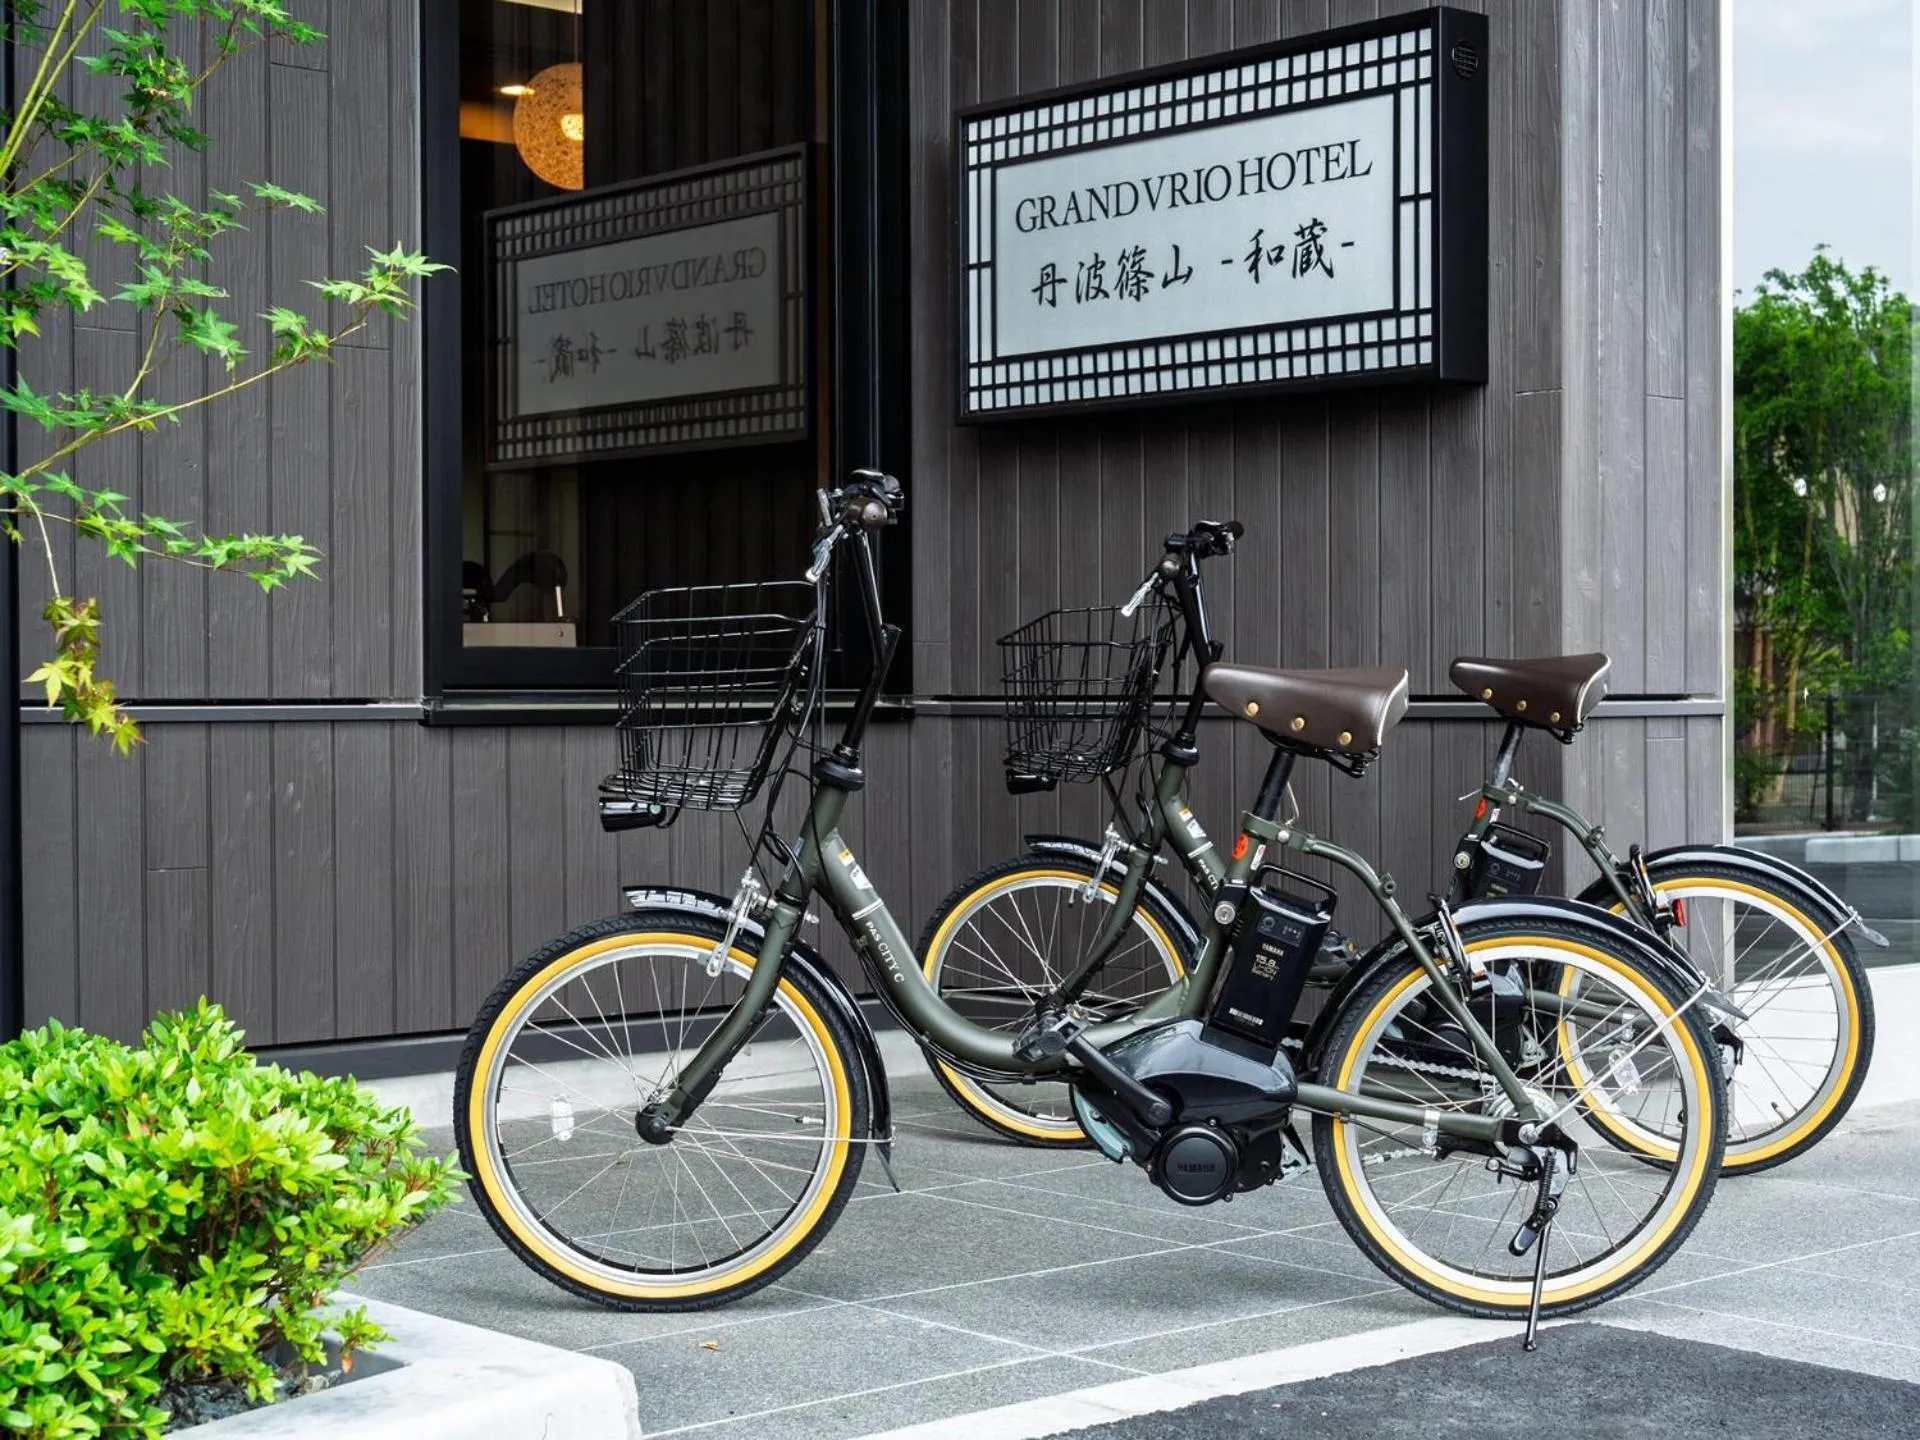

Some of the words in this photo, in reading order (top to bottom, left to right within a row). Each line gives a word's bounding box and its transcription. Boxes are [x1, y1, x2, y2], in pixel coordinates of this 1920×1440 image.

[1015, 164, 1232, 233] GRANDVRIO
[1237, 139, 1373, 197] HOTEL
[1031, 244, 1194, 308] 丹波篠山
[865, 921, 882, 942] PAS
[878, 942, 900, 971] CITY
[893, 972, 905, 983] C
[1176, 1163, 1216, 1174] YAMAHA
